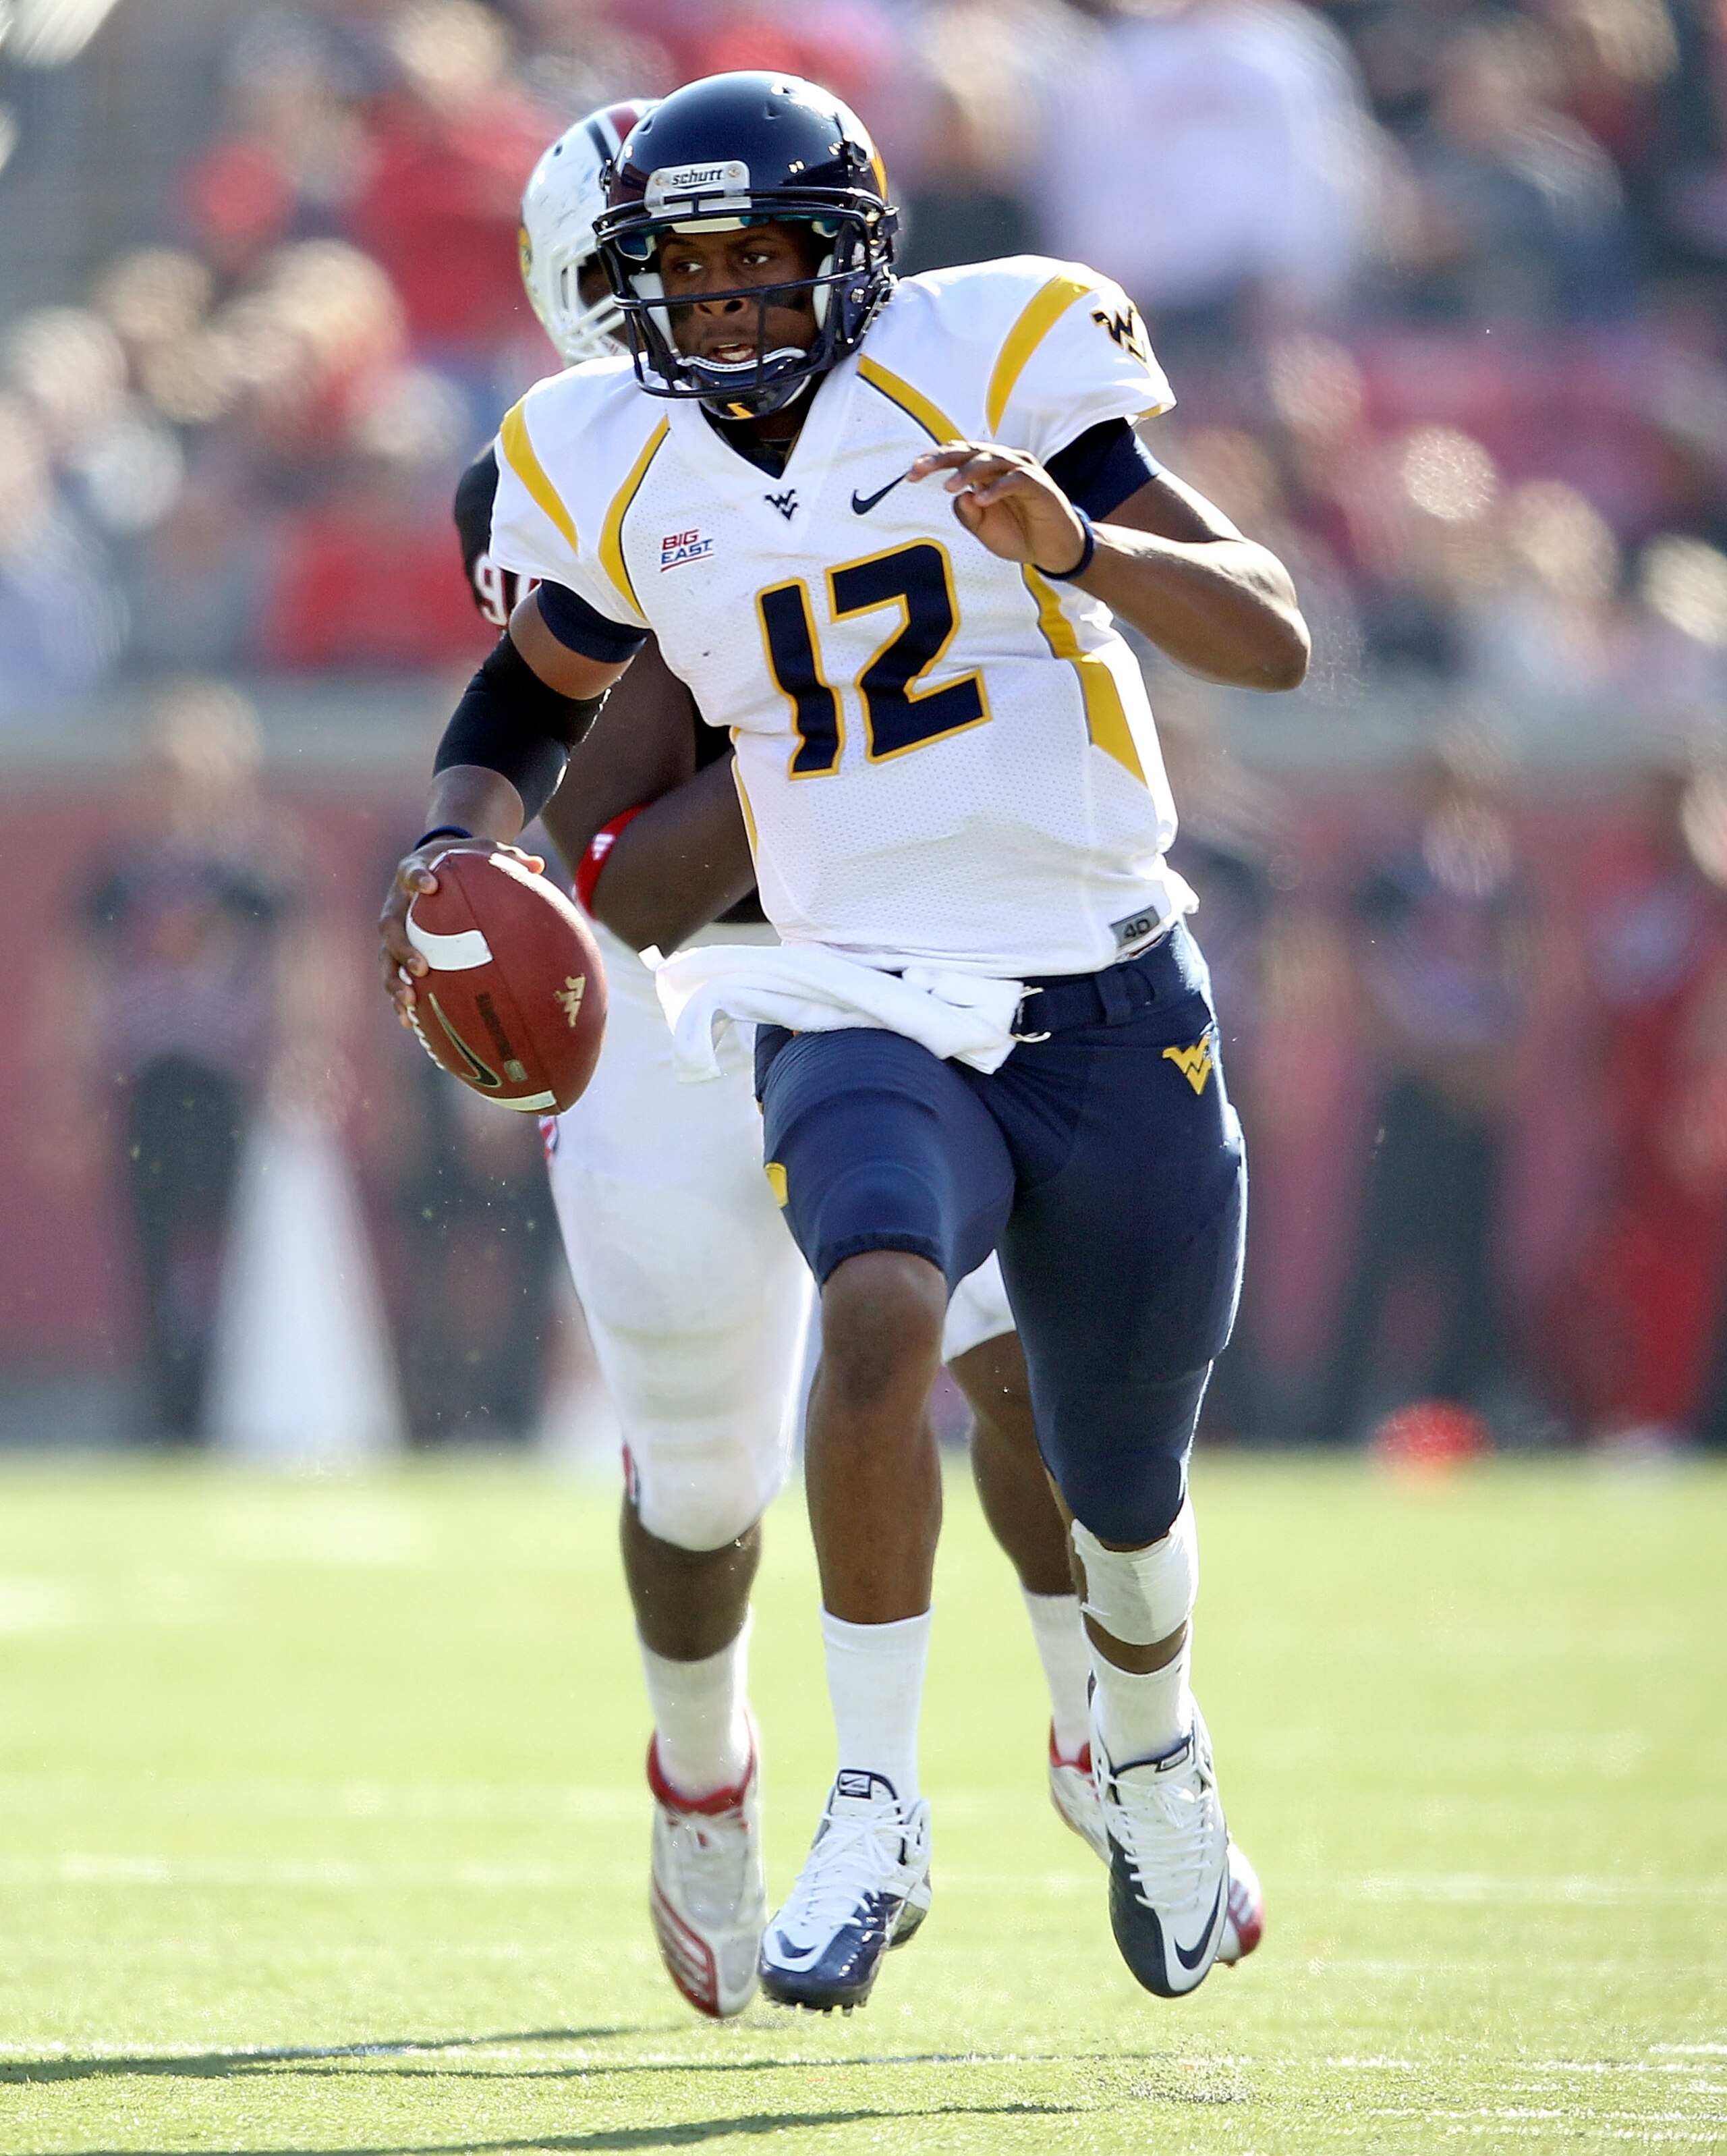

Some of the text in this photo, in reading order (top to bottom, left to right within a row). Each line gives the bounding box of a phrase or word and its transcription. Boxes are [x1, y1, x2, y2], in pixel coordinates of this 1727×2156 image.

[671, 169, 724, 186] schutt
[661, 538, 714, 564] EAST
[662, 529, 700, 551] BIG
[755, 537, 993, 781] 12
